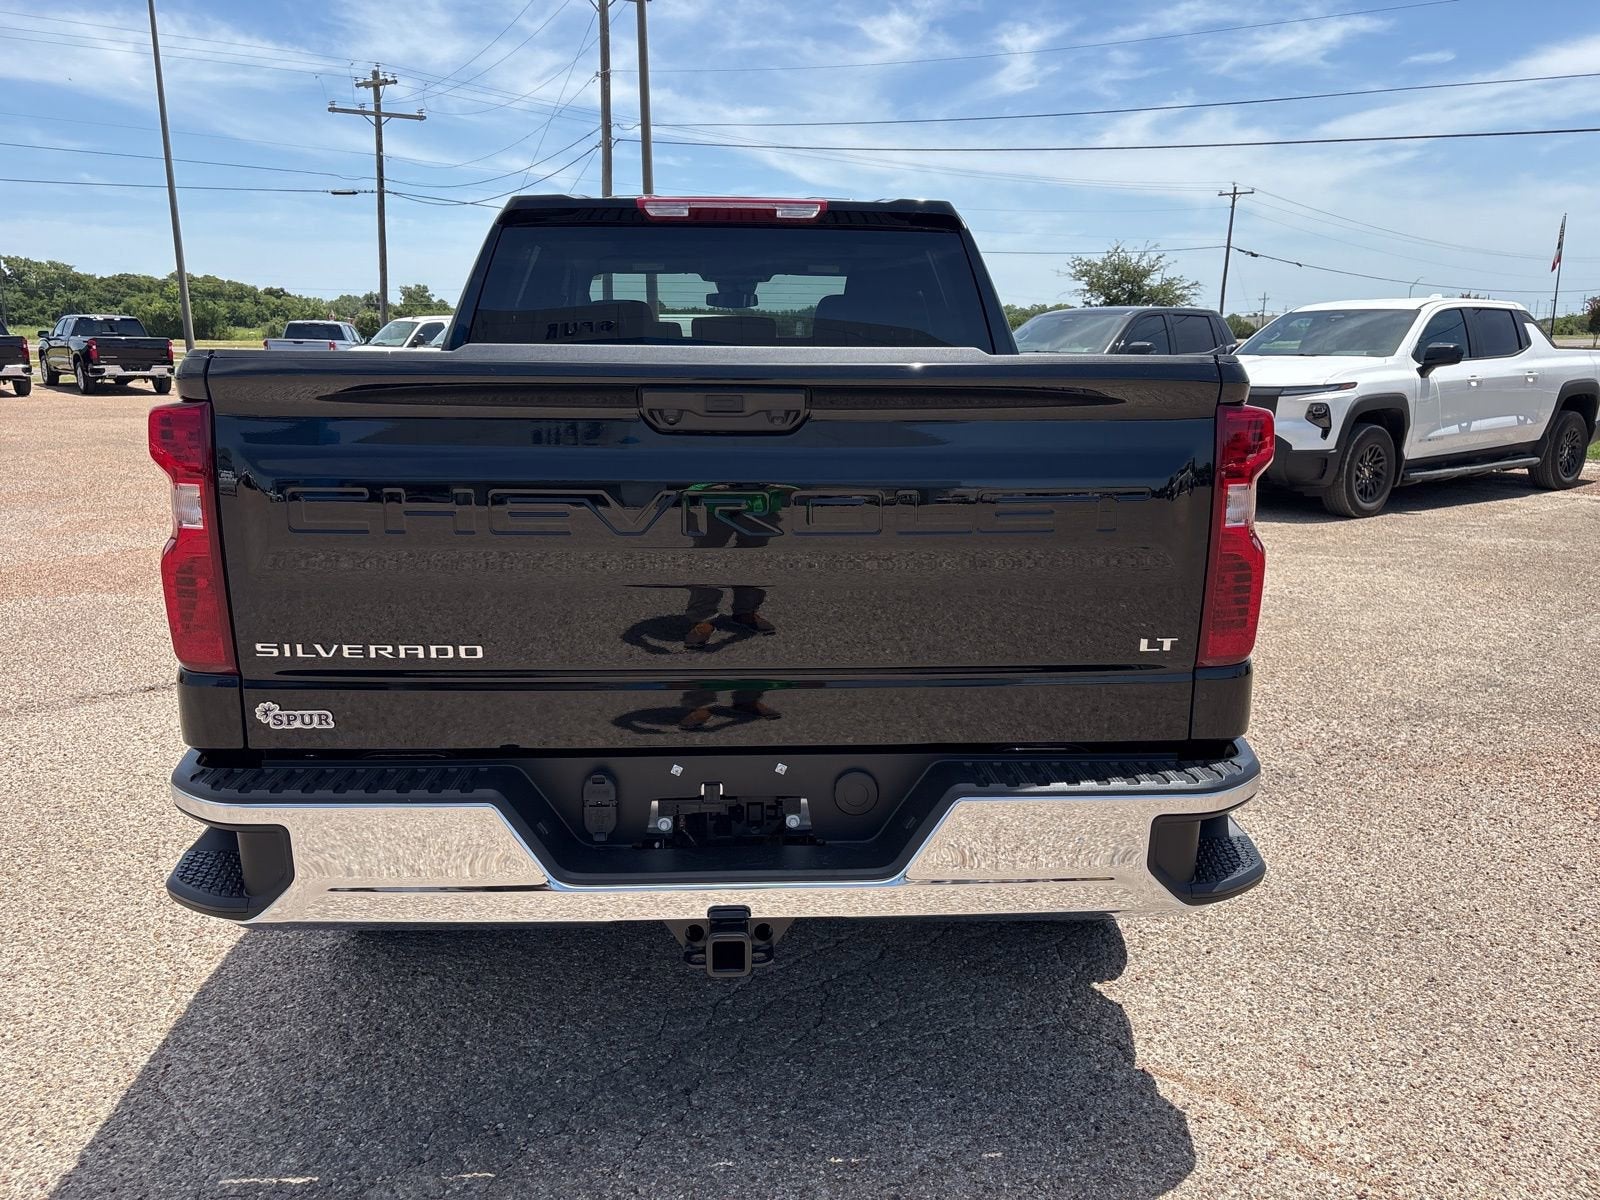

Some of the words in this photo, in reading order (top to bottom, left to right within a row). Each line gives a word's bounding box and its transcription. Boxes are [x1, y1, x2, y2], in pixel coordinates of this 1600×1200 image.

[286, 486, 1153, 536] CHEVROLET
[255, 642, 484, 659] SILVERADO
[1139, 637, 1179, 652] LT
[272, 712, 333, 727] SPUR
